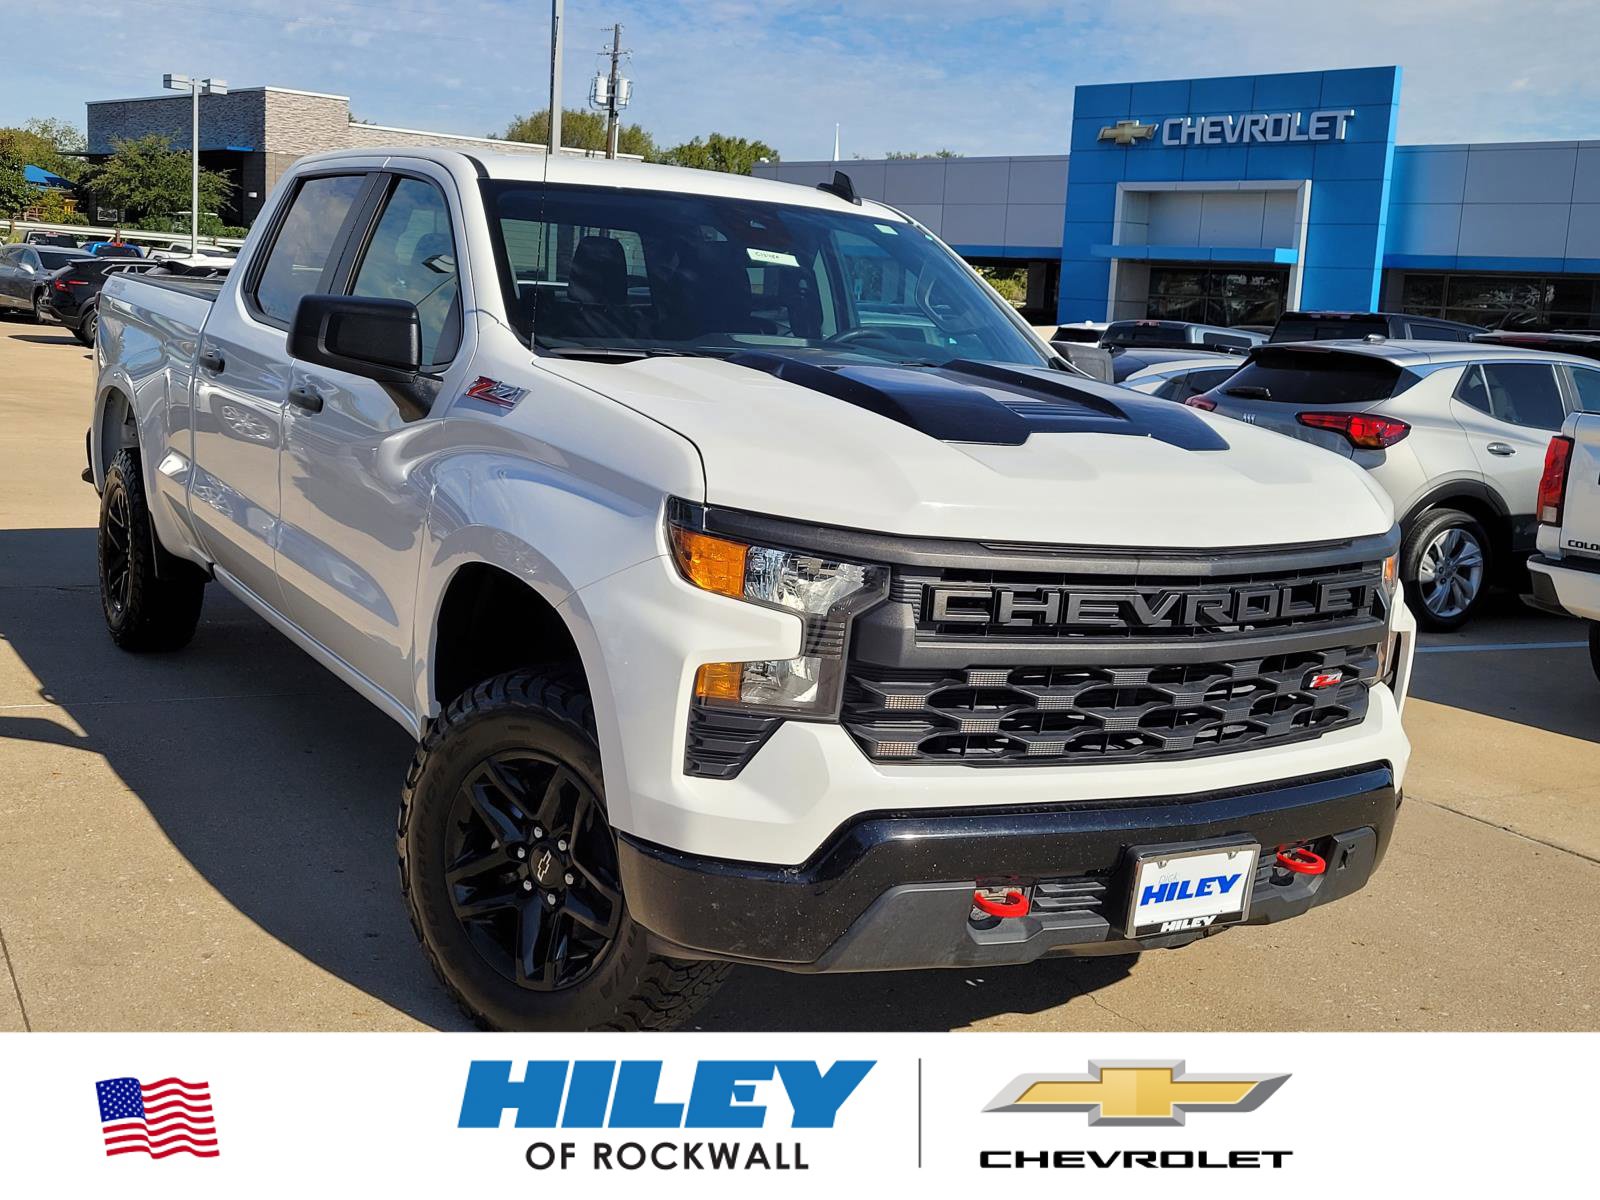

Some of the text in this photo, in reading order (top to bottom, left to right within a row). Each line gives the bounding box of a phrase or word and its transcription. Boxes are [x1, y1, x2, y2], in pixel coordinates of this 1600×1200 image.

[1162, 109, 1355, 146] CHEVROLET
[1139, 873, 1242, 907] HILEY
[1160, 914, 1217, 933] HILEY
